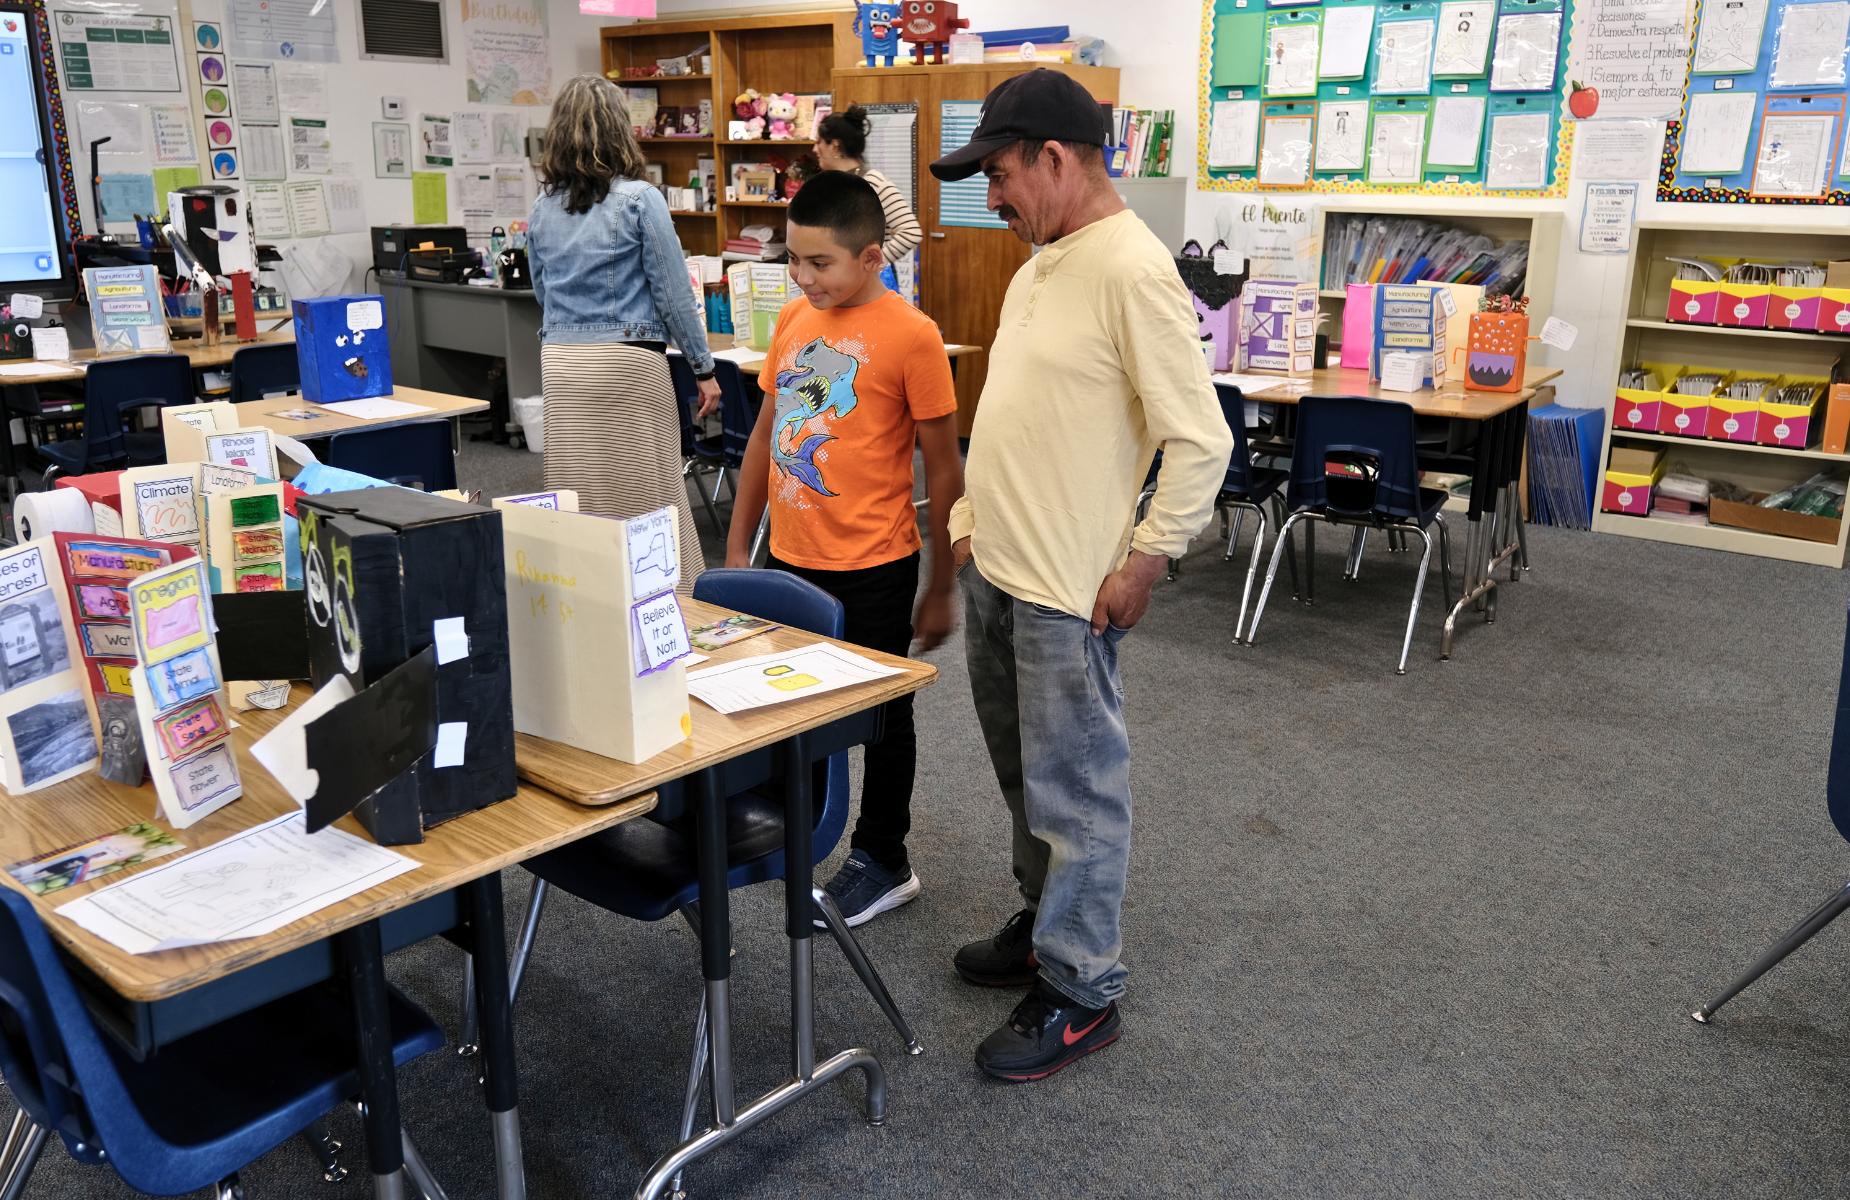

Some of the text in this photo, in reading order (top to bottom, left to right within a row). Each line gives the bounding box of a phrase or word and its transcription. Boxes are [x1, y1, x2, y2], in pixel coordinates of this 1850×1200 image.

[1597, 7, 1647, 22] decisiones
[1597, 21, 1647, 38] Demuestra
[1649, 18, 1686, 42] respeto
[1596, 44, 1641, 60] Resuelve
[1642, 42, 1652, 59] el
[1641, 66, 1655, 83] da
[1602, 88, 1635, 102] mejor
[1242, 204, 1307, 225] El Puente
[98, 273, 142, 282] Manufacturing
[104, 285, 137, 294] Agriculture
[1388, 290, 1430, 299] Manufacturing
[1392, 306, 1423, 315] Agriculture
[1389, 321, 1422, 330] Waterways
[1392, 336, 1424, 344] Landforms
[1255, 358, 1287, 367] Waterways
[222, 436, 255, 448] Rhode
[225, 447, 256, 458] Island
[211, 475, 248, 488] Landforms
[141, 484, 190, 500] Climate
[242, 500, 264, 510] State
[242, 512, 264, 520] Motto
[630, 514, 669, 537] New York
[248, 534, 269, 543] State
[242, 544, 278, 555] Nickname
[22, 554, 38, 570] of
[78, 553, 162, 572] Manufacturing
[246, 574, 268, 583] State
[138, 574, 197, 605] Oregon
[642, 604, 675, 625] Believe
[662, 624, 673, 636] or
[656, 638, 676, 657] Not!
[166, 664, 193, 680] State
[166, 674, 200, 694] Animal
[176, 714, 200, 731] State
[182, 725, 206, 743] Song
[188, 764, 214, 781] State
[190, 775, 220, 796] Flower
